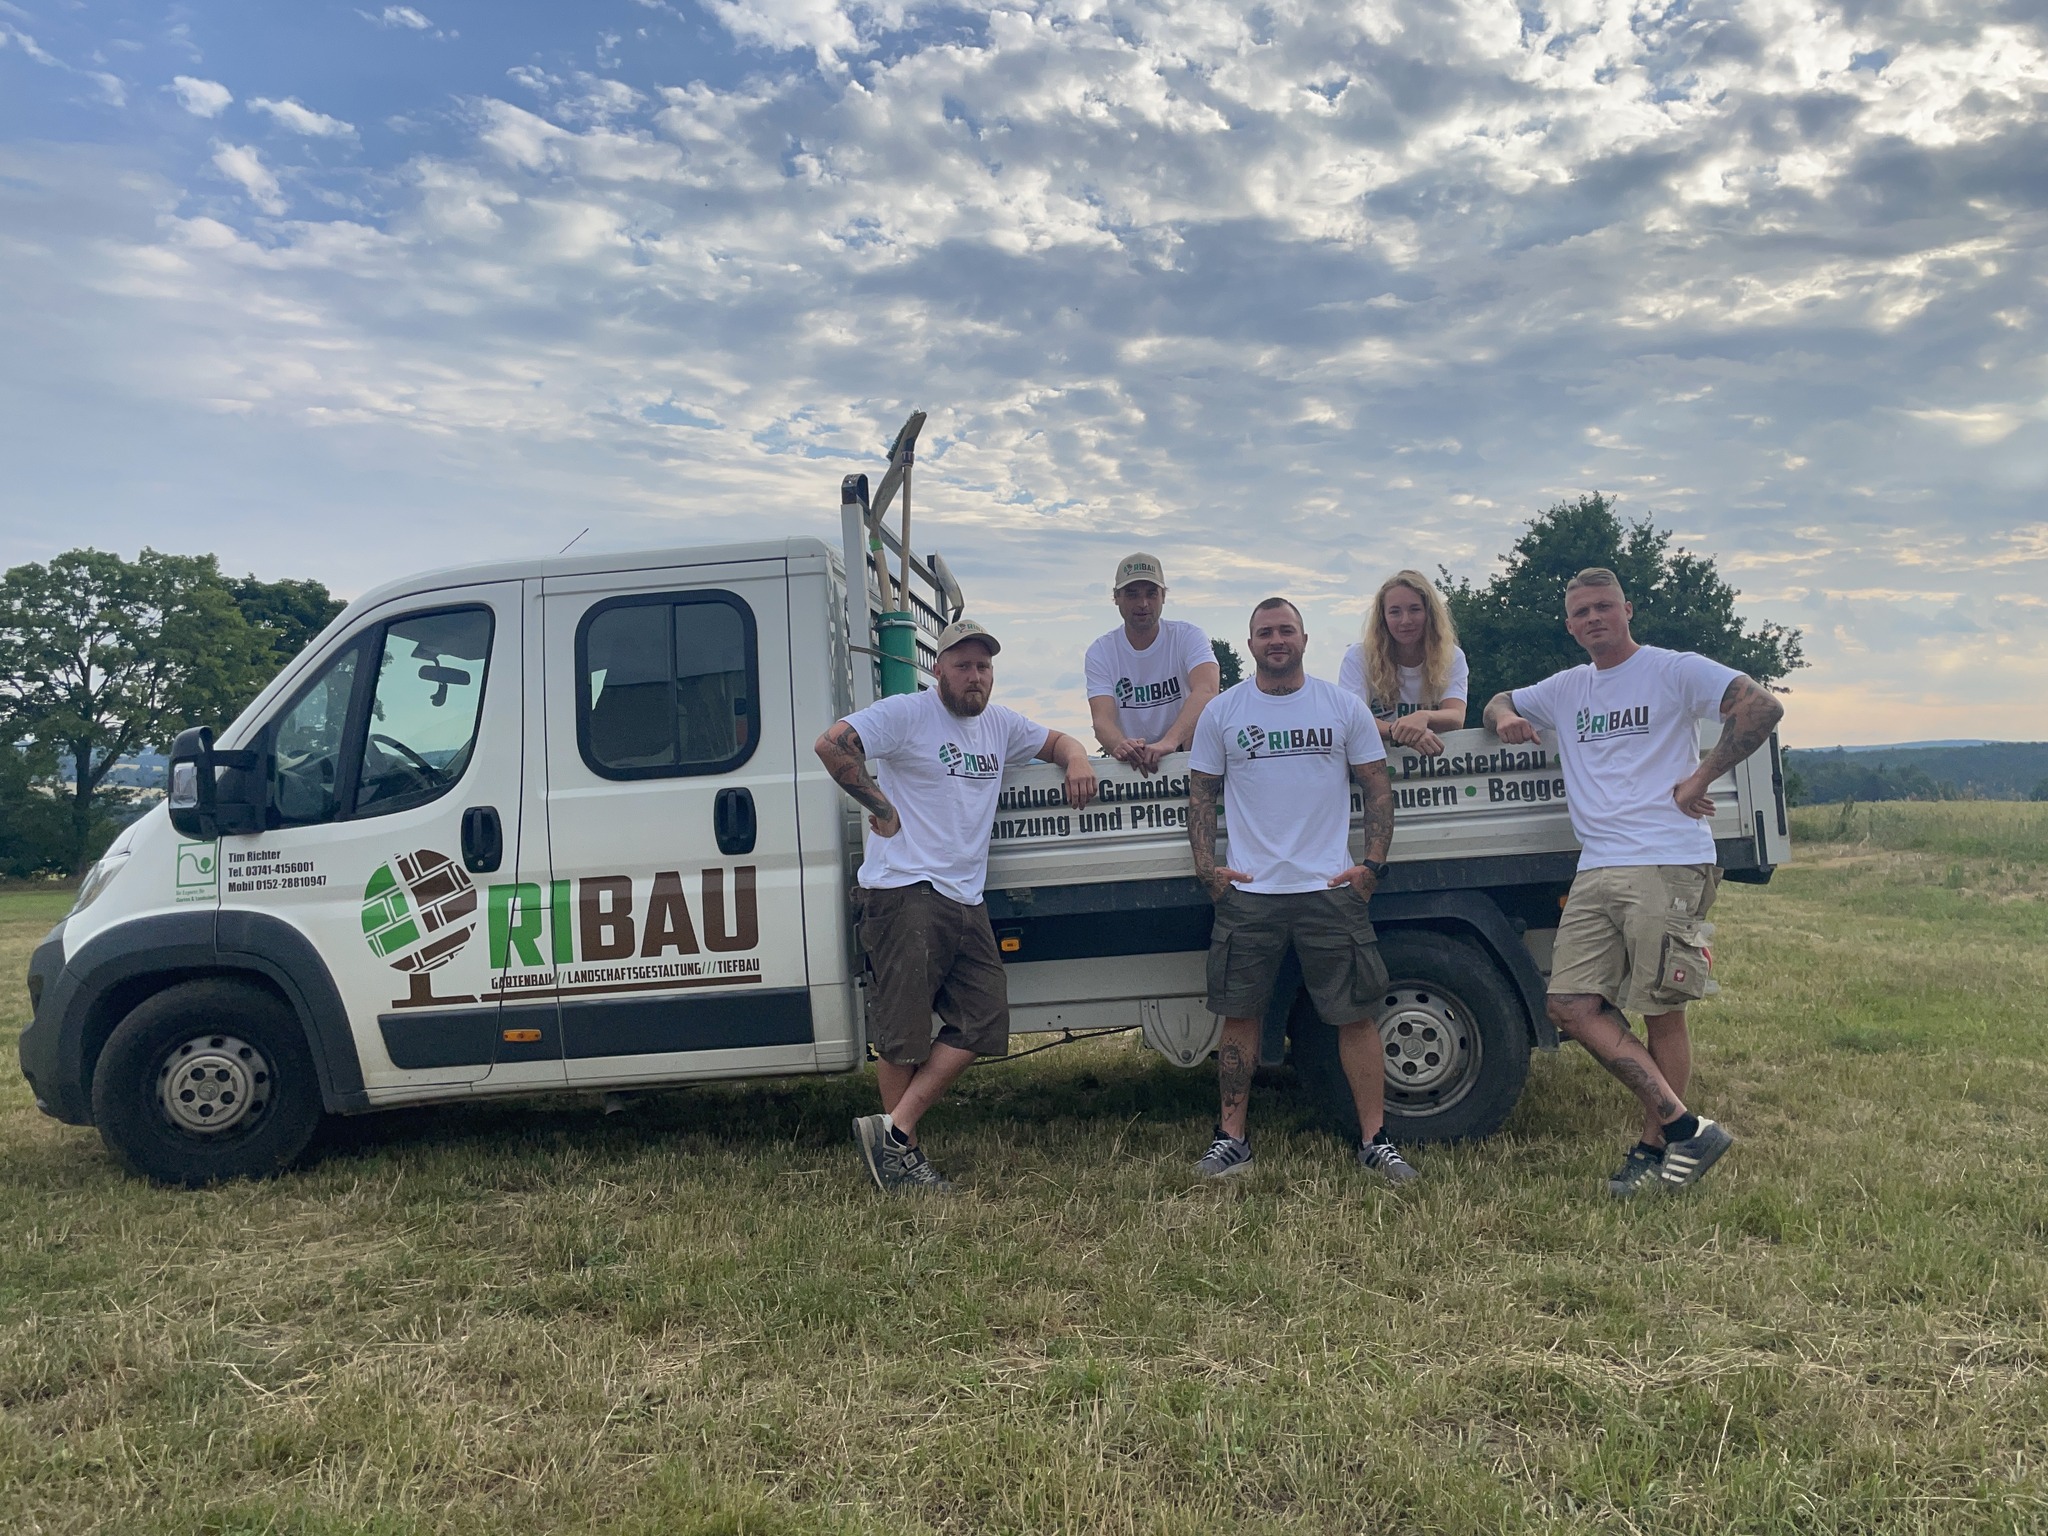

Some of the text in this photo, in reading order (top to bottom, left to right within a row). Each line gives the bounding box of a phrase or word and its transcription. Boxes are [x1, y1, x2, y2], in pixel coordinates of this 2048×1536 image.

[1134, 676, 1181, 703] RIBAU
[1591, 705, 1649, 734] RIBAU
[1268, 728, 1333, 751] RIBAU
[963, 752, 999, 772] RIBAU
[1099, 774, 1190, 803] Grundst
[1402, 748, 1546, 779] Pflasterbau
[990, 815, 1071, 840] anzung
[1079, 806, 1122, 833] und
[1130, 803, 1190, 829] Pfleg
[1488, 778, 1566, 803] Bagge
[228, 850, 281, 863] Tim Richter
[228, 861, 314, 878] Tel. 03741-4156001
[228, 875, 327, 892] Mobil 0152-28810947
[487, 865, 760, 970] RIBAU
